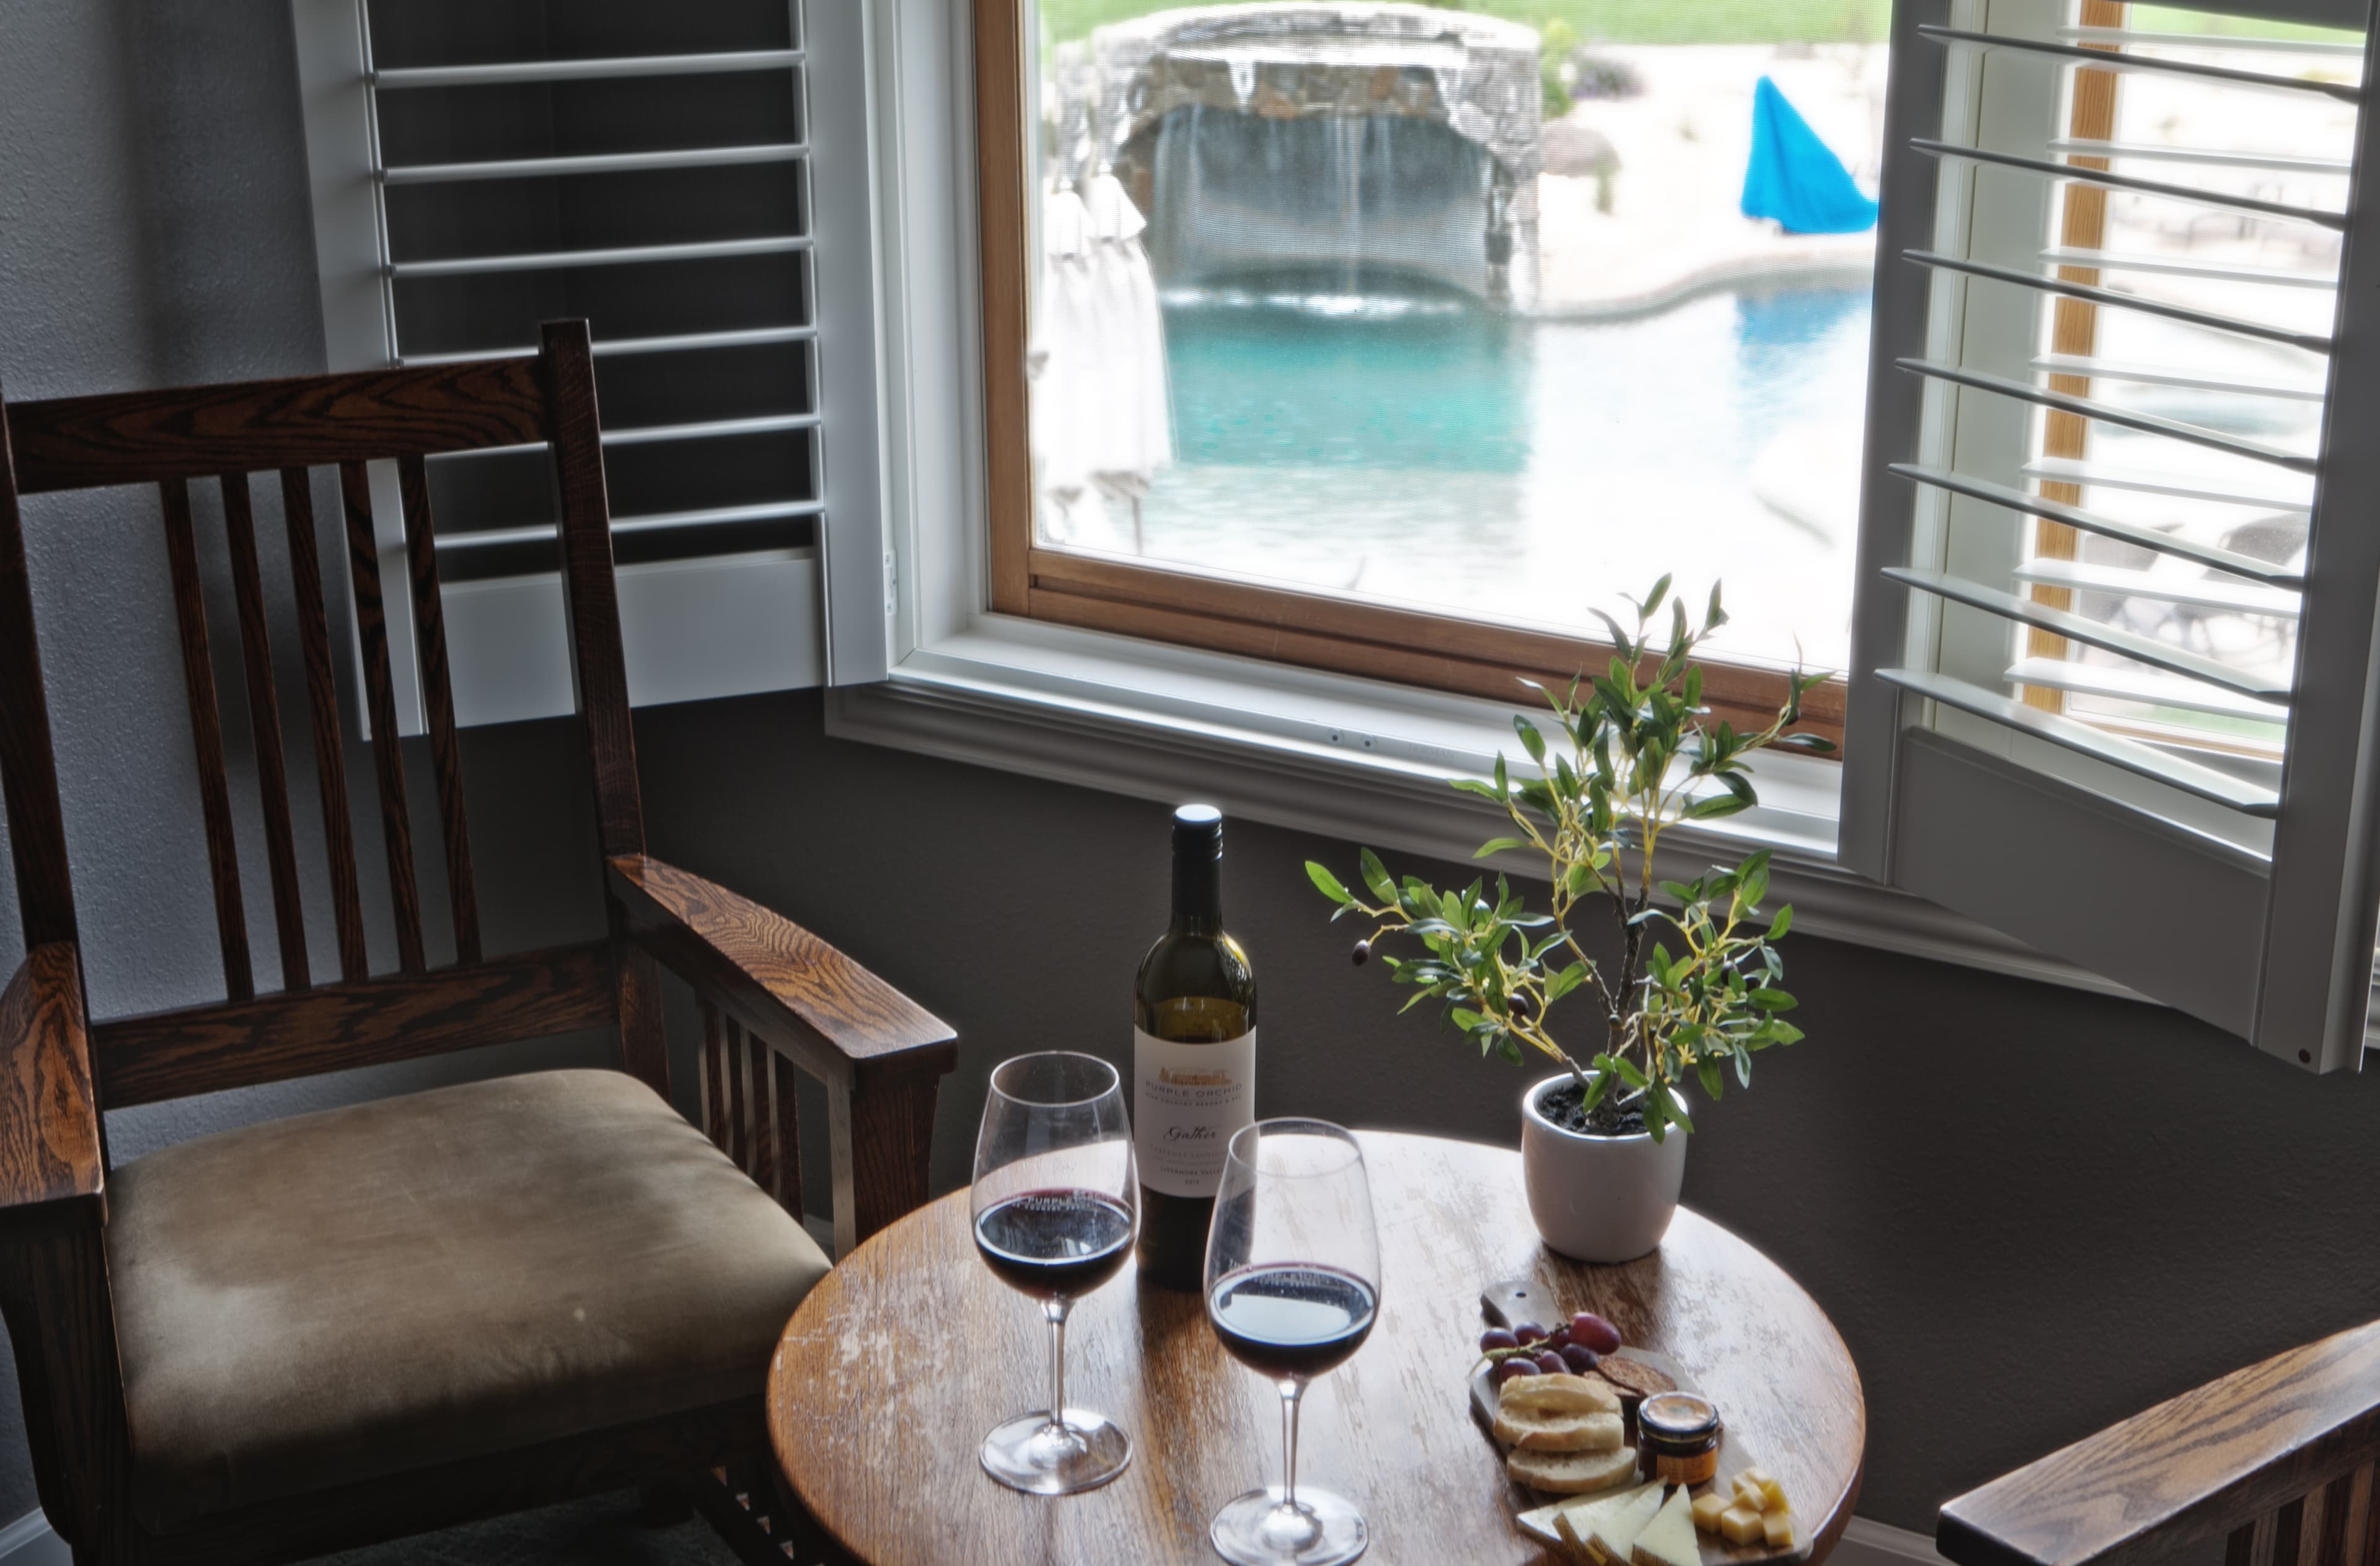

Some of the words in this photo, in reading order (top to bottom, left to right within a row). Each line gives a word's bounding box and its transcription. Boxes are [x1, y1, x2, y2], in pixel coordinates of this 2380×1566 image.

[1145, 1080, 1189, 1097] PURPLE
[1196, 1083, 1242, 1097] ORCHID
[1163, 1125, 1217, 1142] Gather
